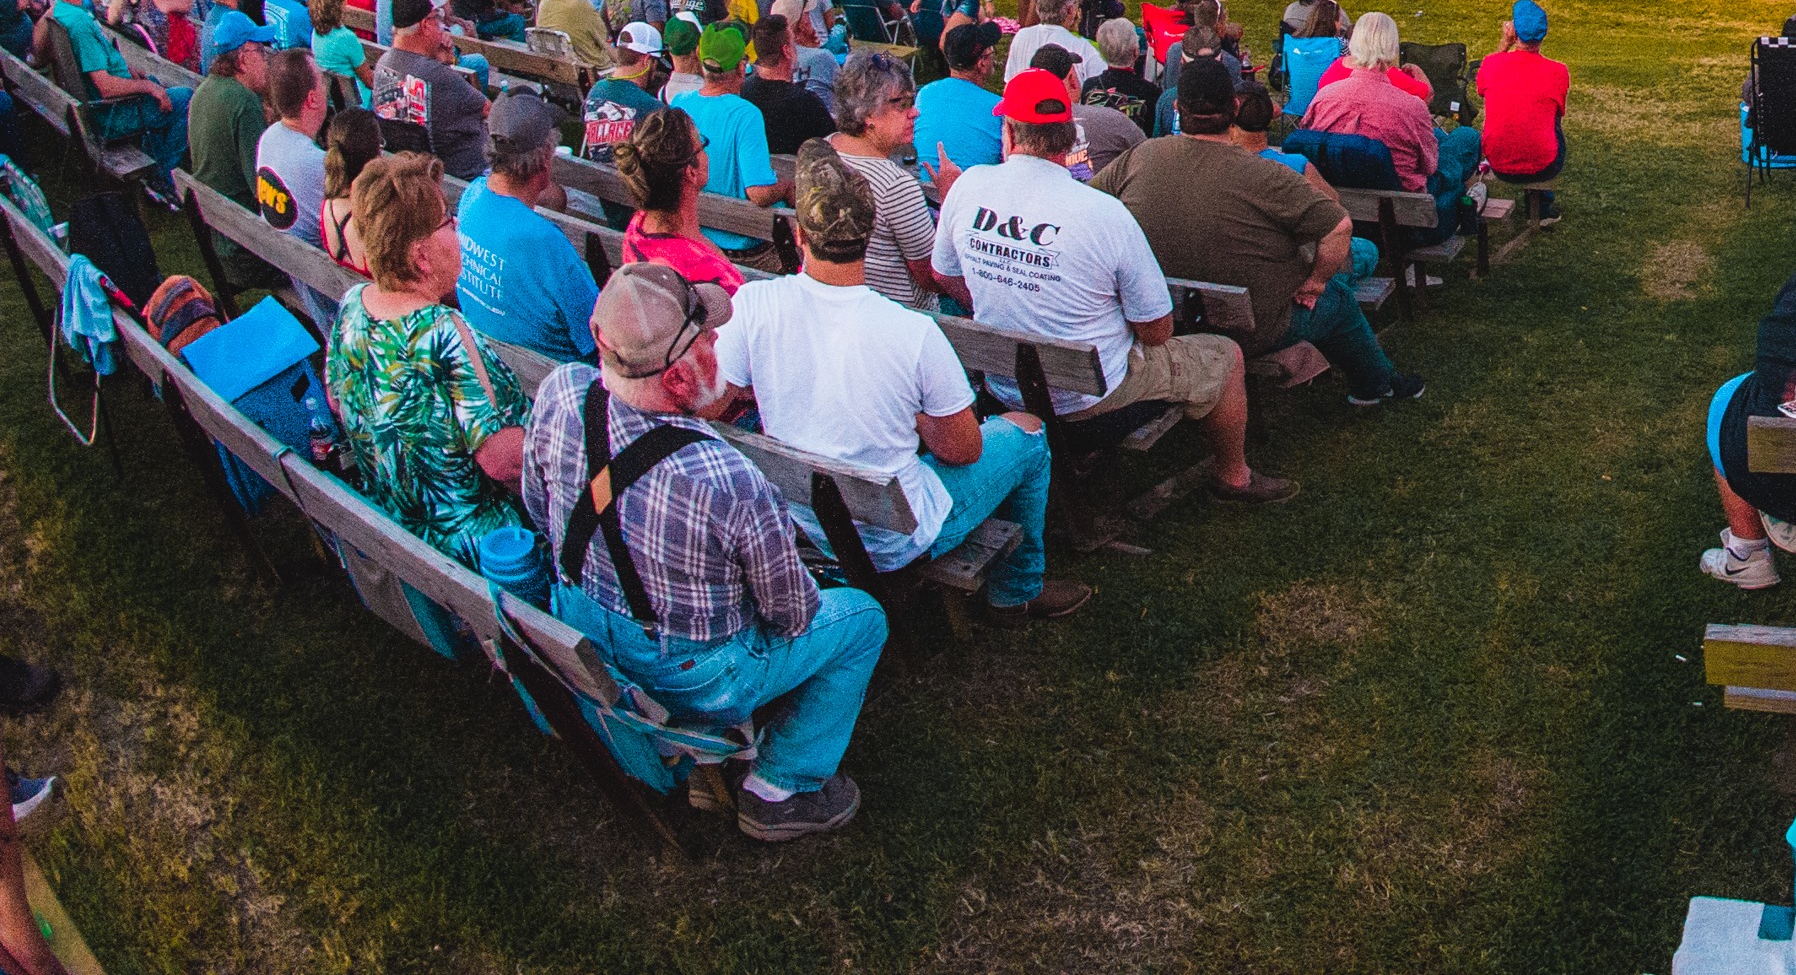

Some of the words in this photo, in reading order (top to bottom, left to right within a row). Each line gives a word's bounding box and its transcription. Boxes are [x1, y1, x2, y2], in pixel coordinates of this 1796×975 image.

[972, 205, 1061, 247] D&C
[969, 237, 1051, 268] CONTRACTORS
[460, 268, 503, 300] STITUTE
[972, 267, 1041, 293] 1-800-646-2405
[1011, 266, 1028, 277] SEAL
[1028, 270, 1062, 282] COATING
